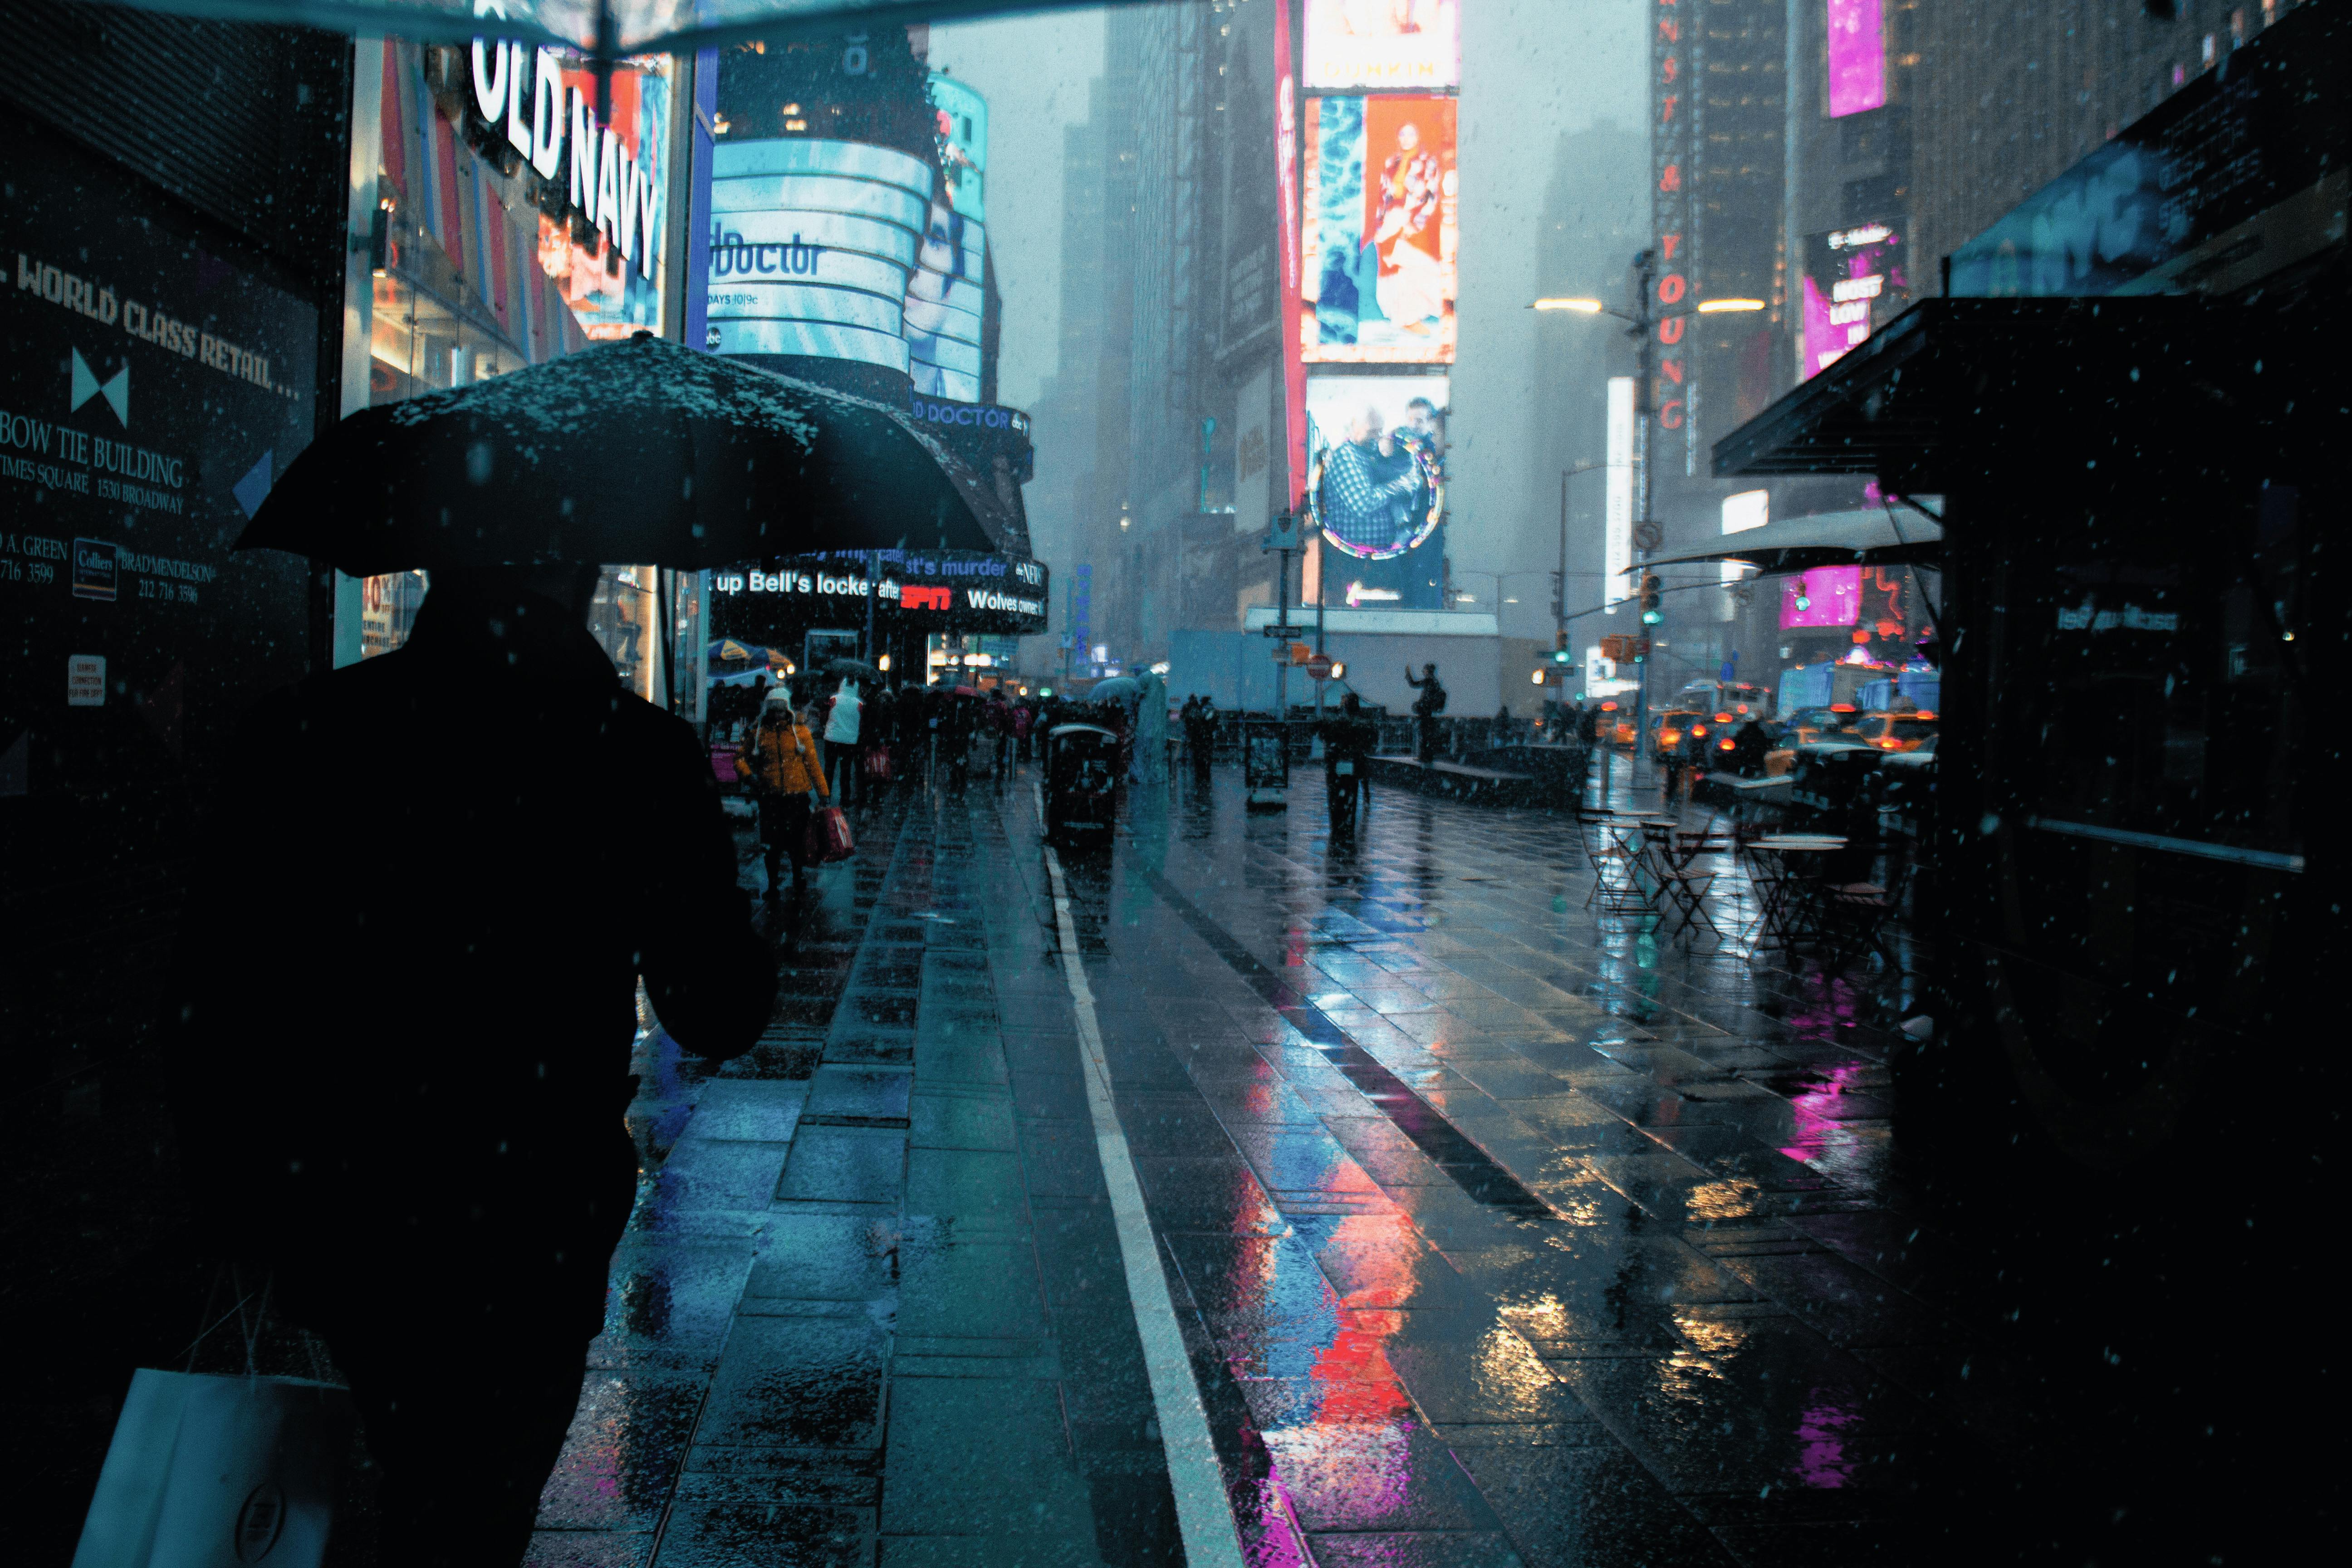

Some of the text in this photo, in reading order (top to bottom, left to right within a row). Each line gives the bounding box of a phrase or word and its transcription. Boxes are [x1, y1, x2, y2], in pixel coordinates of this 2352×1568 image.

[1657, 0, 1680, 123] NST
[472, 35, 657, 281] OLD NAVY
[715, 233, 827, 277] Doctor
[17, 251, 119, 326] WORLD
[123, 298, 199, 359] CLASS
[1658, 234, 1687, 430] YOUNG
[928, 403, 1010, 431] DOCTOR
[0, 410, 184, 489] BOW TIE BUILDING
[0, 454, 184, 516] IMES SQUARE 1530 BROADWAY
[23, 534, 68, 561] GREEN
[78, 548, 113, 571] Colliers
[0, 559, 22, 581] 716
[26, 562, 54, 585] 3599
[121, 551, 150, 574] BRAD
[151, 554, 211, 583] MENDELSON
[941, 558, 1007, 577] murder
[138, 578, 155, 598] 212
[158, 580, 175, 601] 716
[716, 573, 744, 596] up
[749, 568, 812, 593] Bell's
[817, 570, 876, 597] locke
[967, 589, 1018, 612] Wolves
